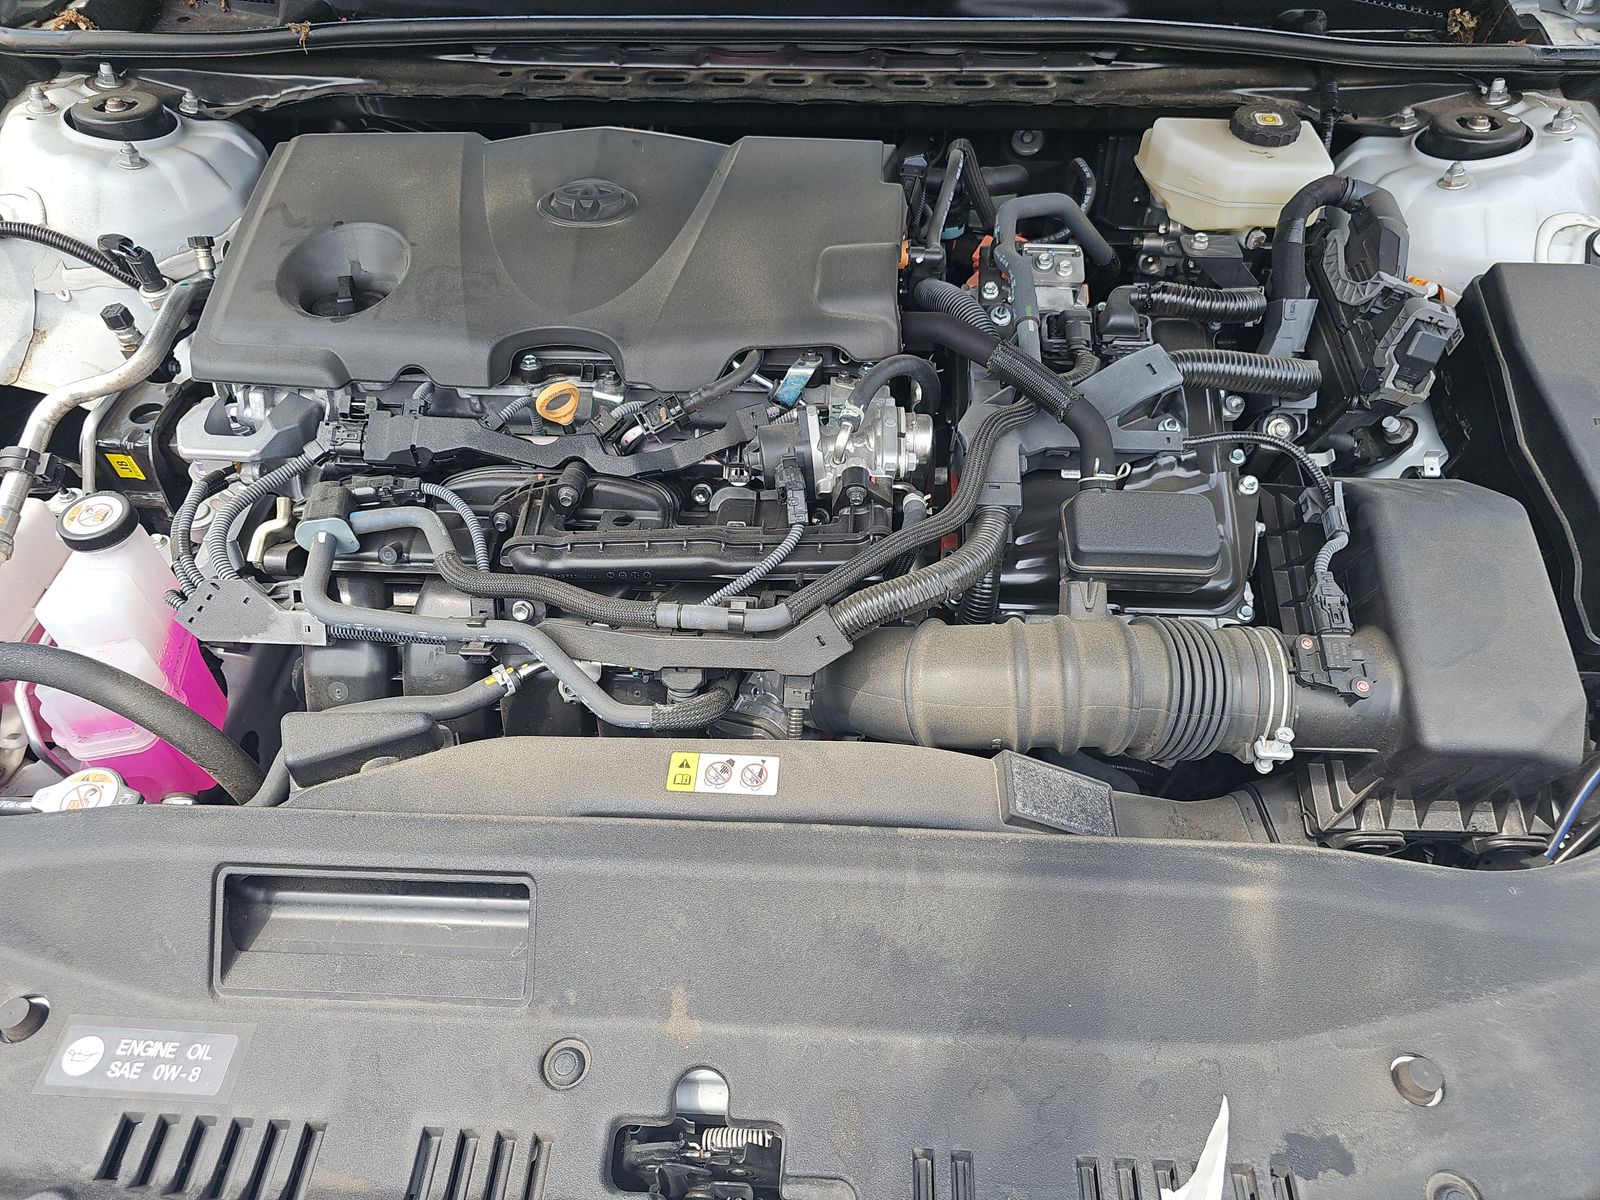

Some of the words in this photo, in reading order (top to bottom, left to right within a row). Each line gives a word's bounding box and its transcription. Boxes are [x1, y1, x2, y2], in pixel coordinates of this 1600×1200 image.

[115, 1038, 180, 1059] ENGINE
[186, 1043, 213, 1061] OIL
[106, 1060, 145, 1080] SAE
[152, 1063, 202, 1083] 0W-8
